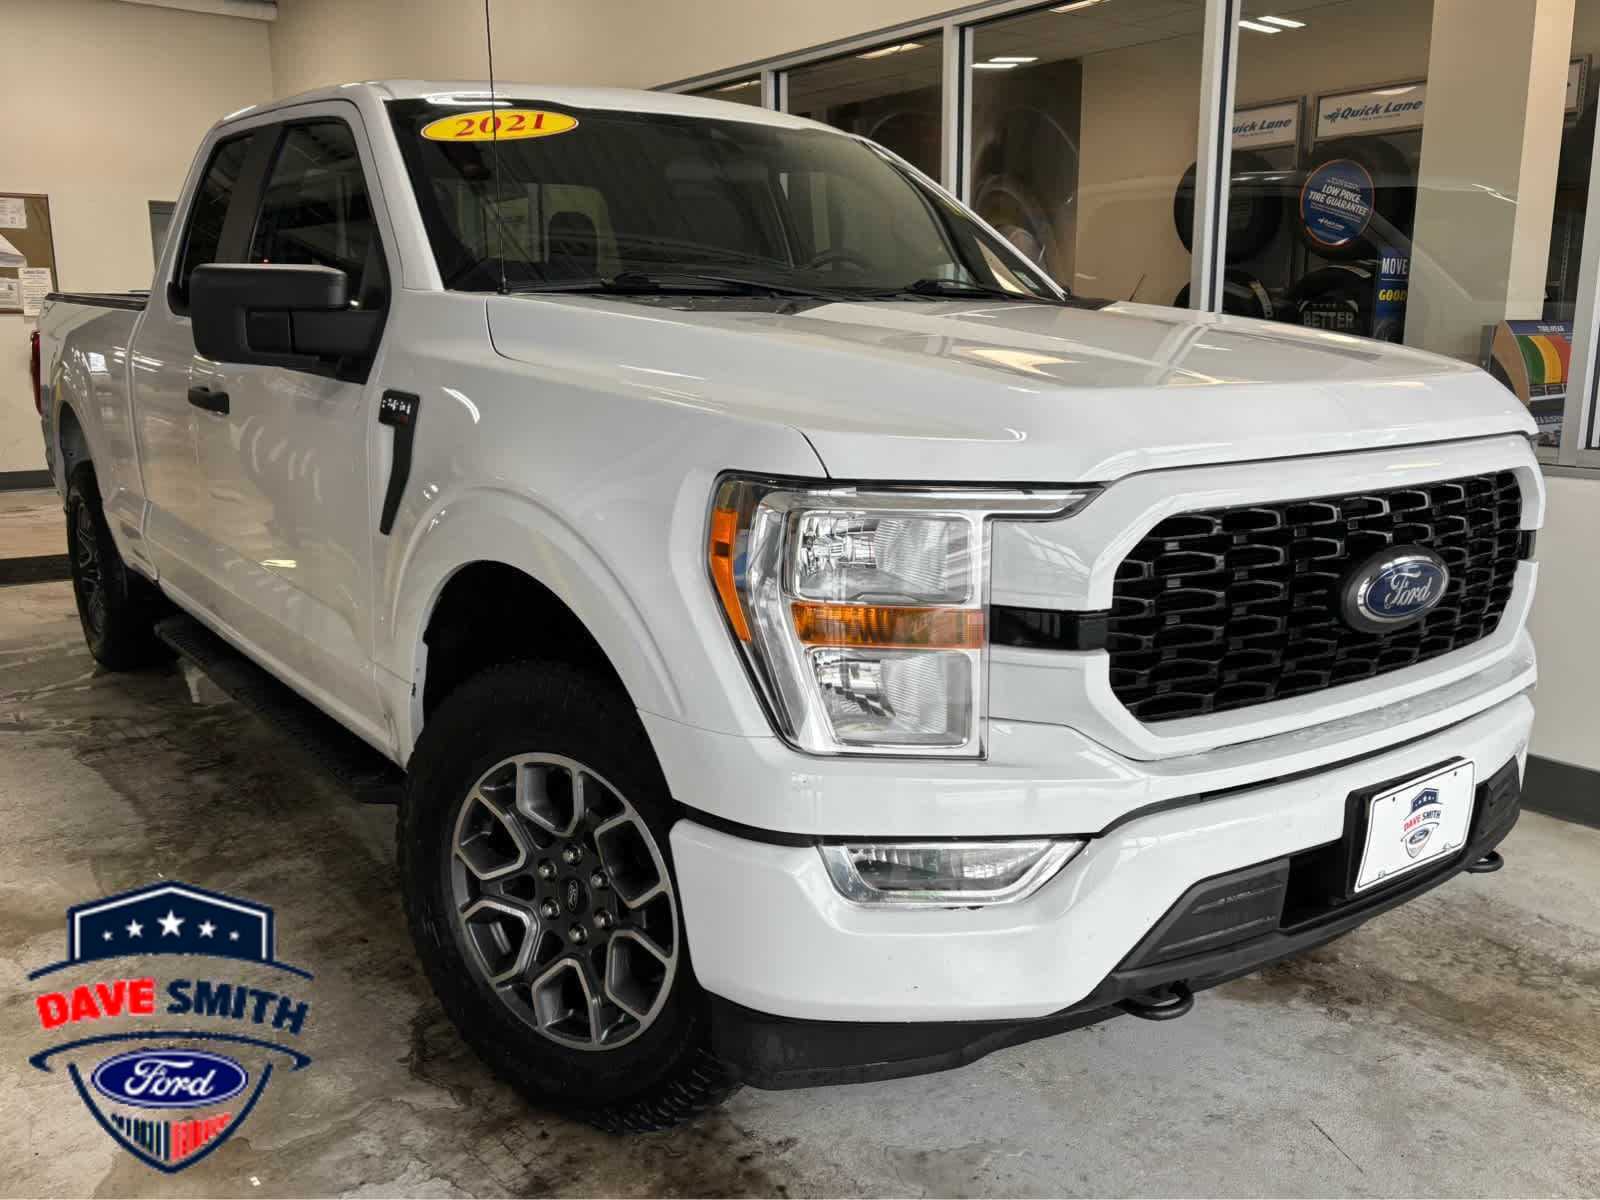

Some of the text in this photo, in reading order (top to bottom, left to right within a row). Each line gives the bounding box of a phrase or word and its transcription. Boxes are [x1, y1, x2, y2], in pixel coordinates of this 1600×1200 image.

[1340, 103, 1382, 120] Quick
[1384, 99, 1424, 113] Lane
[455, 113, 545, 137] 2021
[1232, 120, 1258, 134] uick
[1259, 118, 1292, 130] Lane
[1308, 191, 1327, 203] TIRE
[1326, 196, 1369, 216] GUARANTEE
[1322, 184, 1341, 197] LOW
[1340, 189, 1362, 203] PRICE
[1381, 257, 1408, 275] MOVE
[1303, 310, 1354, 329] BETTER
[1384, 569, 1433, 610] Ford
[1403, 809, 1442, 832] DAVE SMITH
